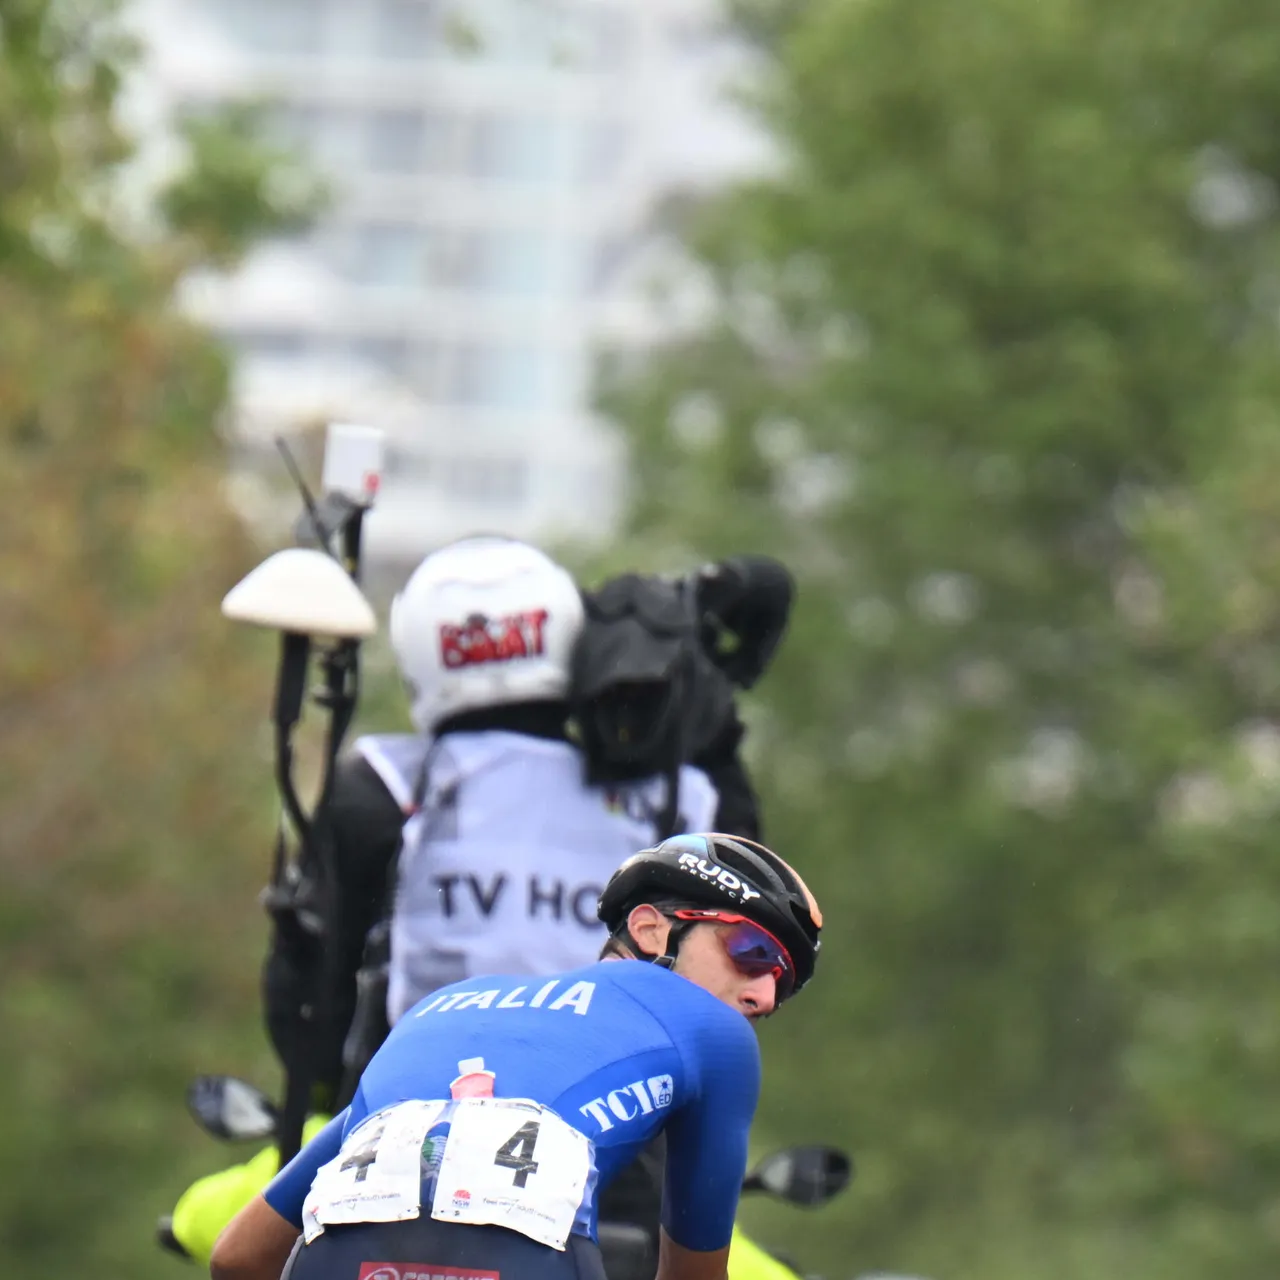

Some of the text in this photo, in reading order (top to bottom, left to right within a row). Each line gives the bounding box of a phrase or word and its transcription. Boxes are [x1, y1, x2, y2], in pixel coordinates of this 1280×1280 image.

[433, 871, 507, 920] TV
[678, 853, 761, 901] RUDY
[680, 865, 746, 905] PROJECT
[415, 979, 596, 1017] ITALIA
[579, 1080, 654, 1133] TCI
[494, 1120, 541, 1188] 4
[452, 1199, 470, 1208] NSW
